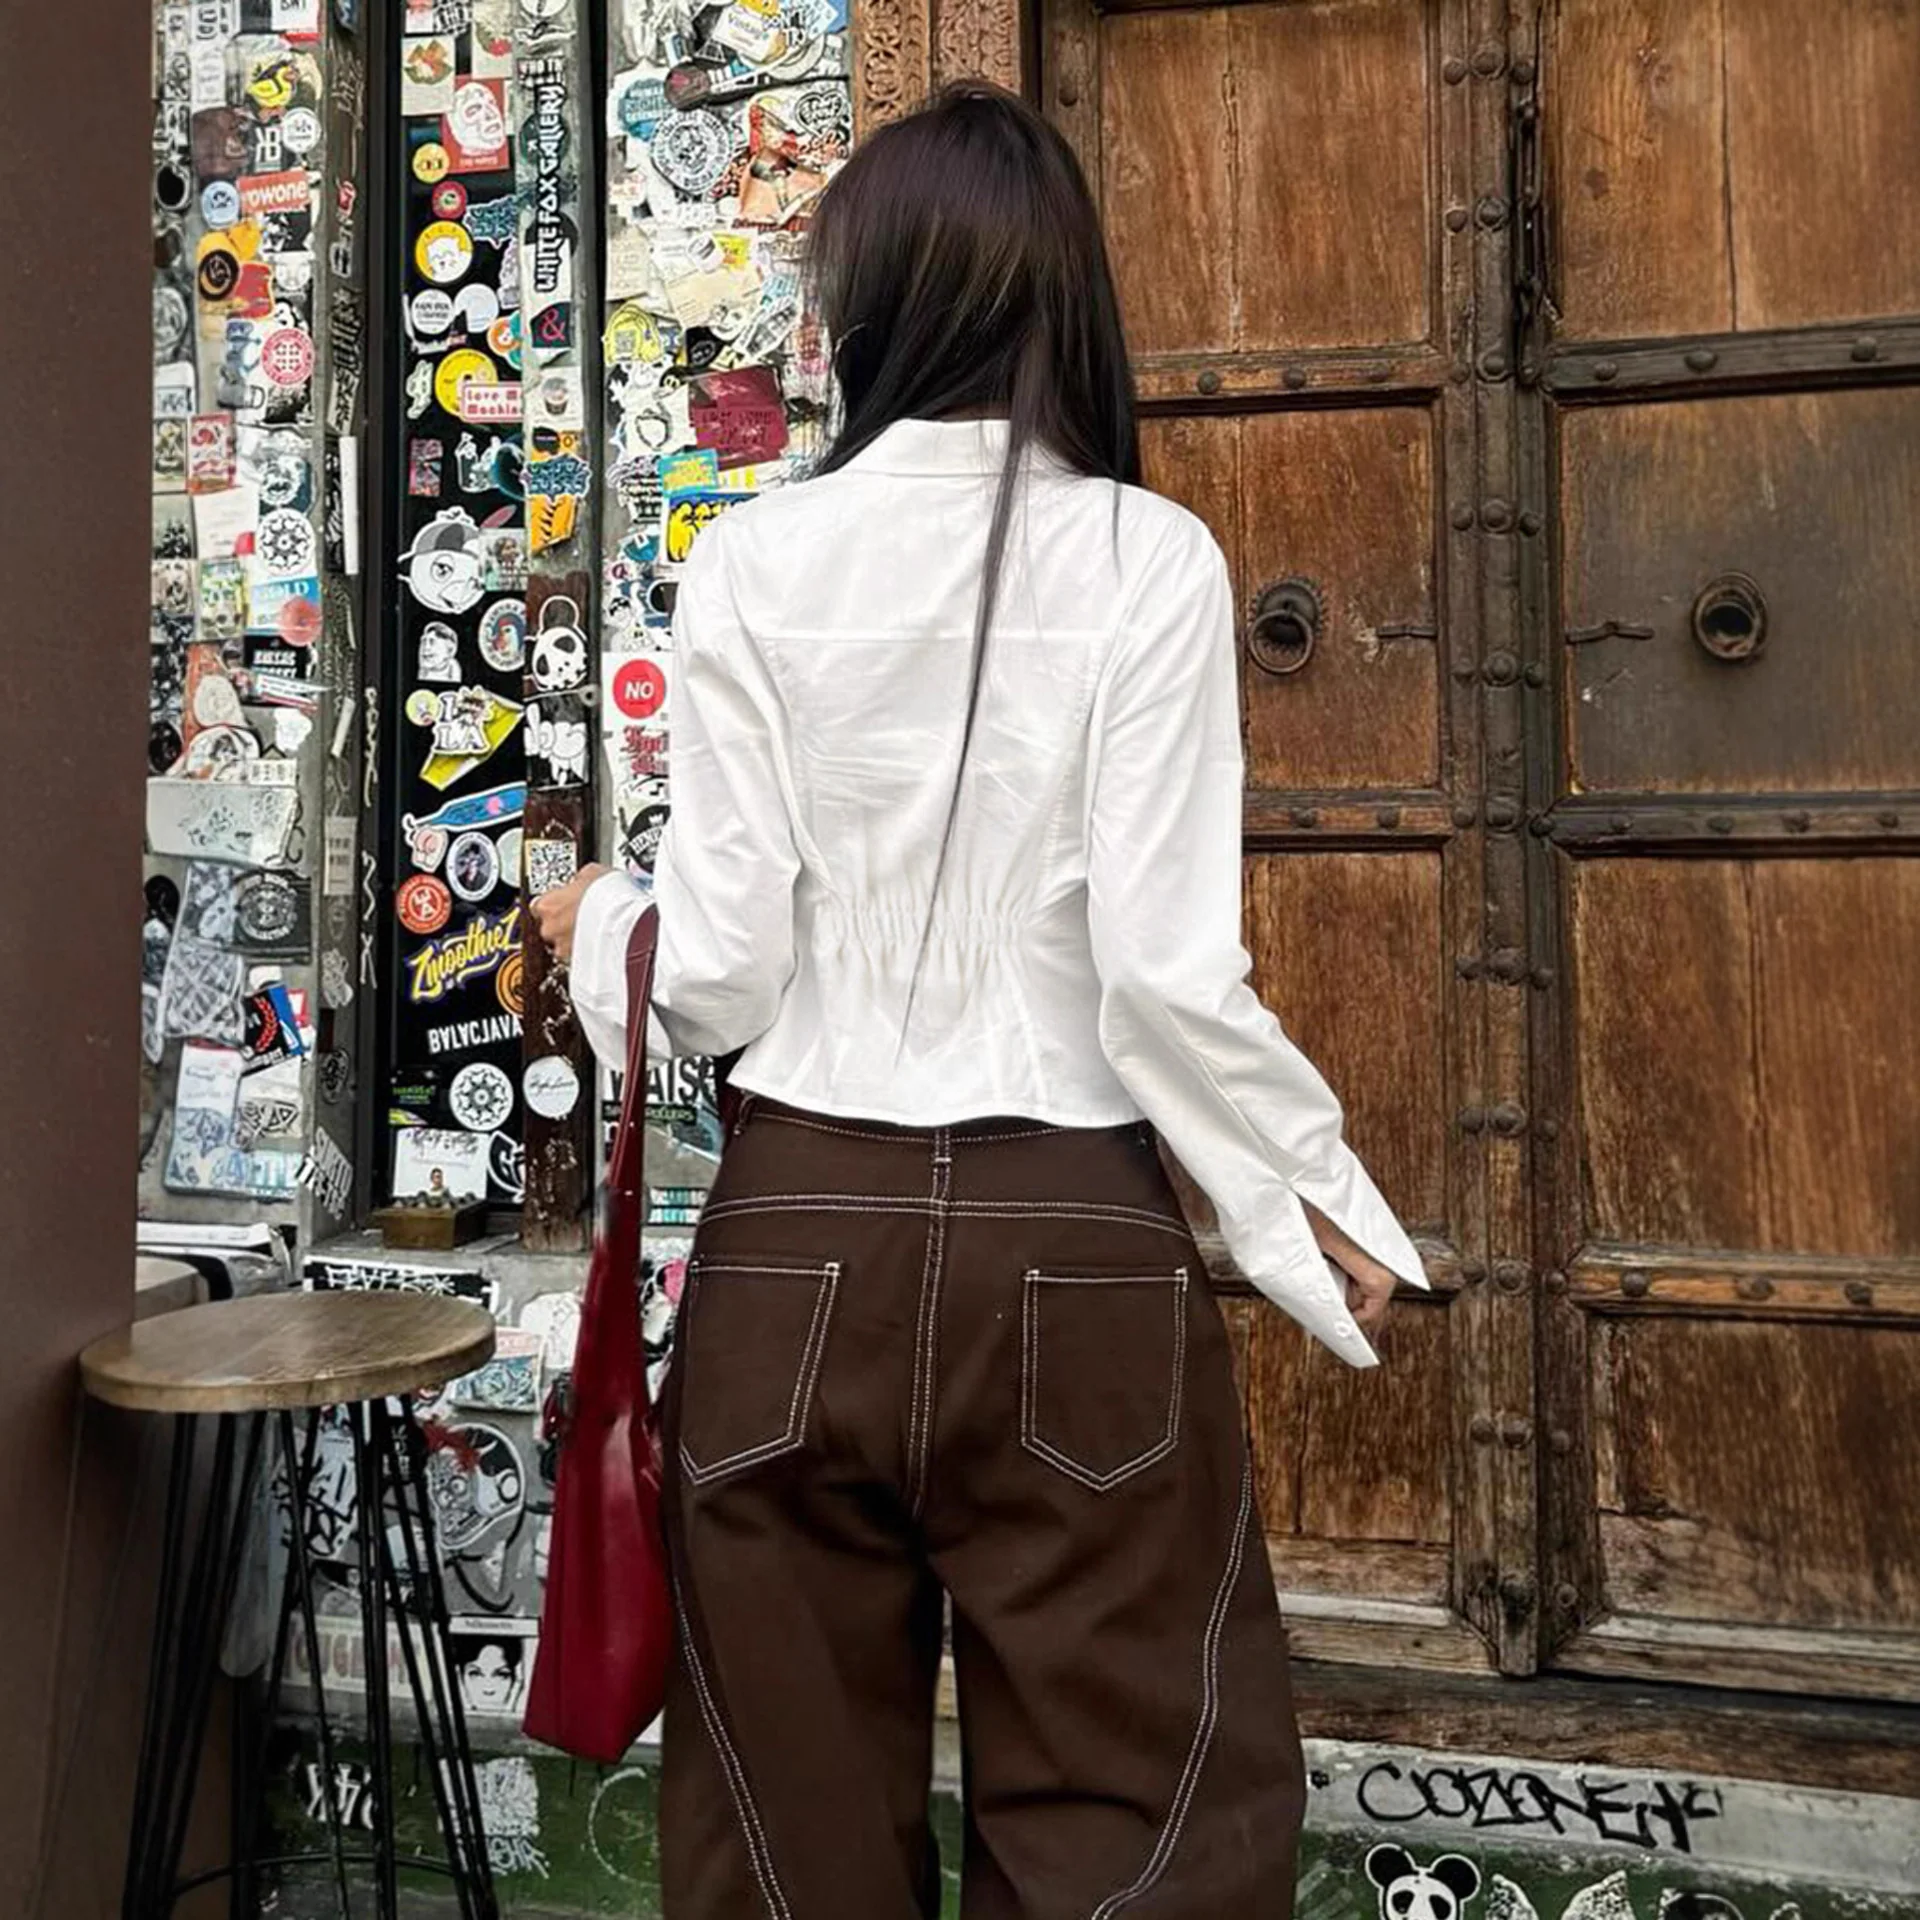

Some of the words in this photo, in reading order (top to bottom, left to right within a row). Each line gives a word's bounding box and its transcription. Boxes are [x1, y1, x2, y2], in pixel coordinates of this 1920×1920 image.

[539, 85, 566, 175] GALLERY
[537, 227, 563, 291] WHITE
[624, 681, 654, 700] NO
